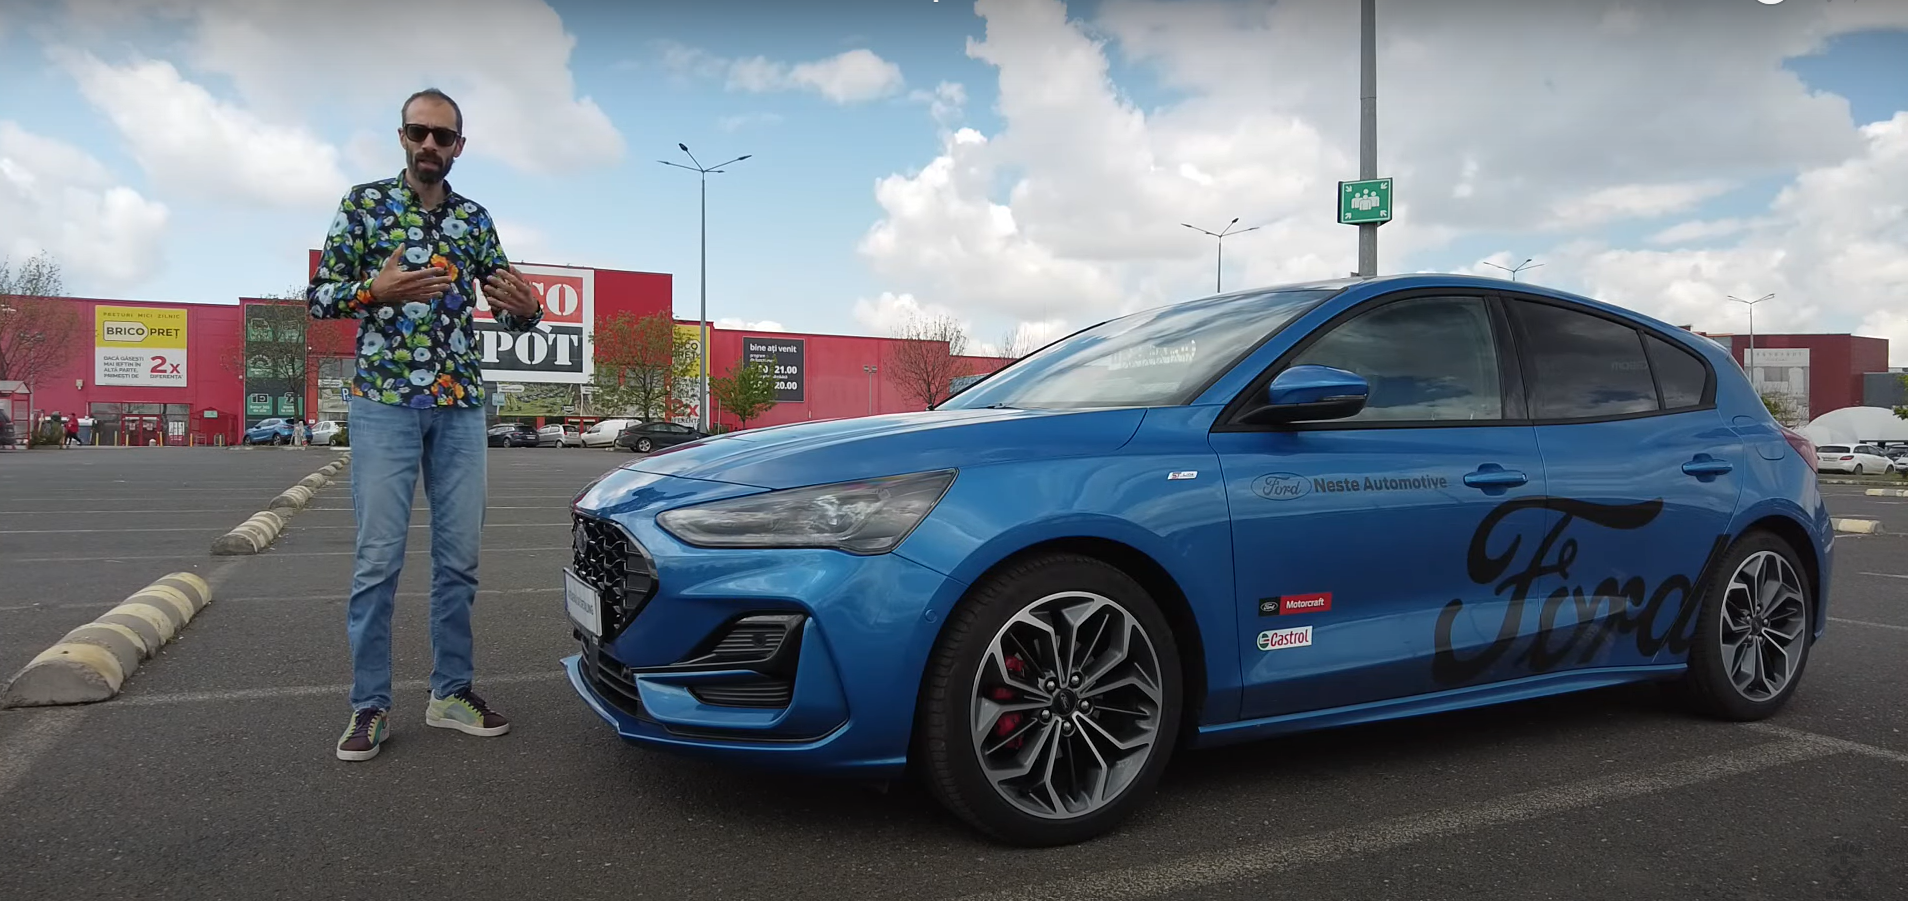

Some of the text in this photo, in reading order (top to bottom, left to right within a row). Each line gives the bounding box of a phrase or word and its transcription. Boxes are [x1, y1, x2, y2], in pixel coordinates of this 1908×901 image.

[106, 327, 180, 339] BRICO PREȚ
[474, 322, 579, 366] PÔT
[150, 356, 181, 374] 2x
[774, 365, 798, 374] 21.00
[774, 381, 798, 390] 20.00
[1263, 474, 1448, 496] Ford Neste Automotive
[1433, 495, 1731, 682] Ford
[1286, 598, 1324, 609] Motorcraft
[1270, 629, 1309, 646] Castrol
